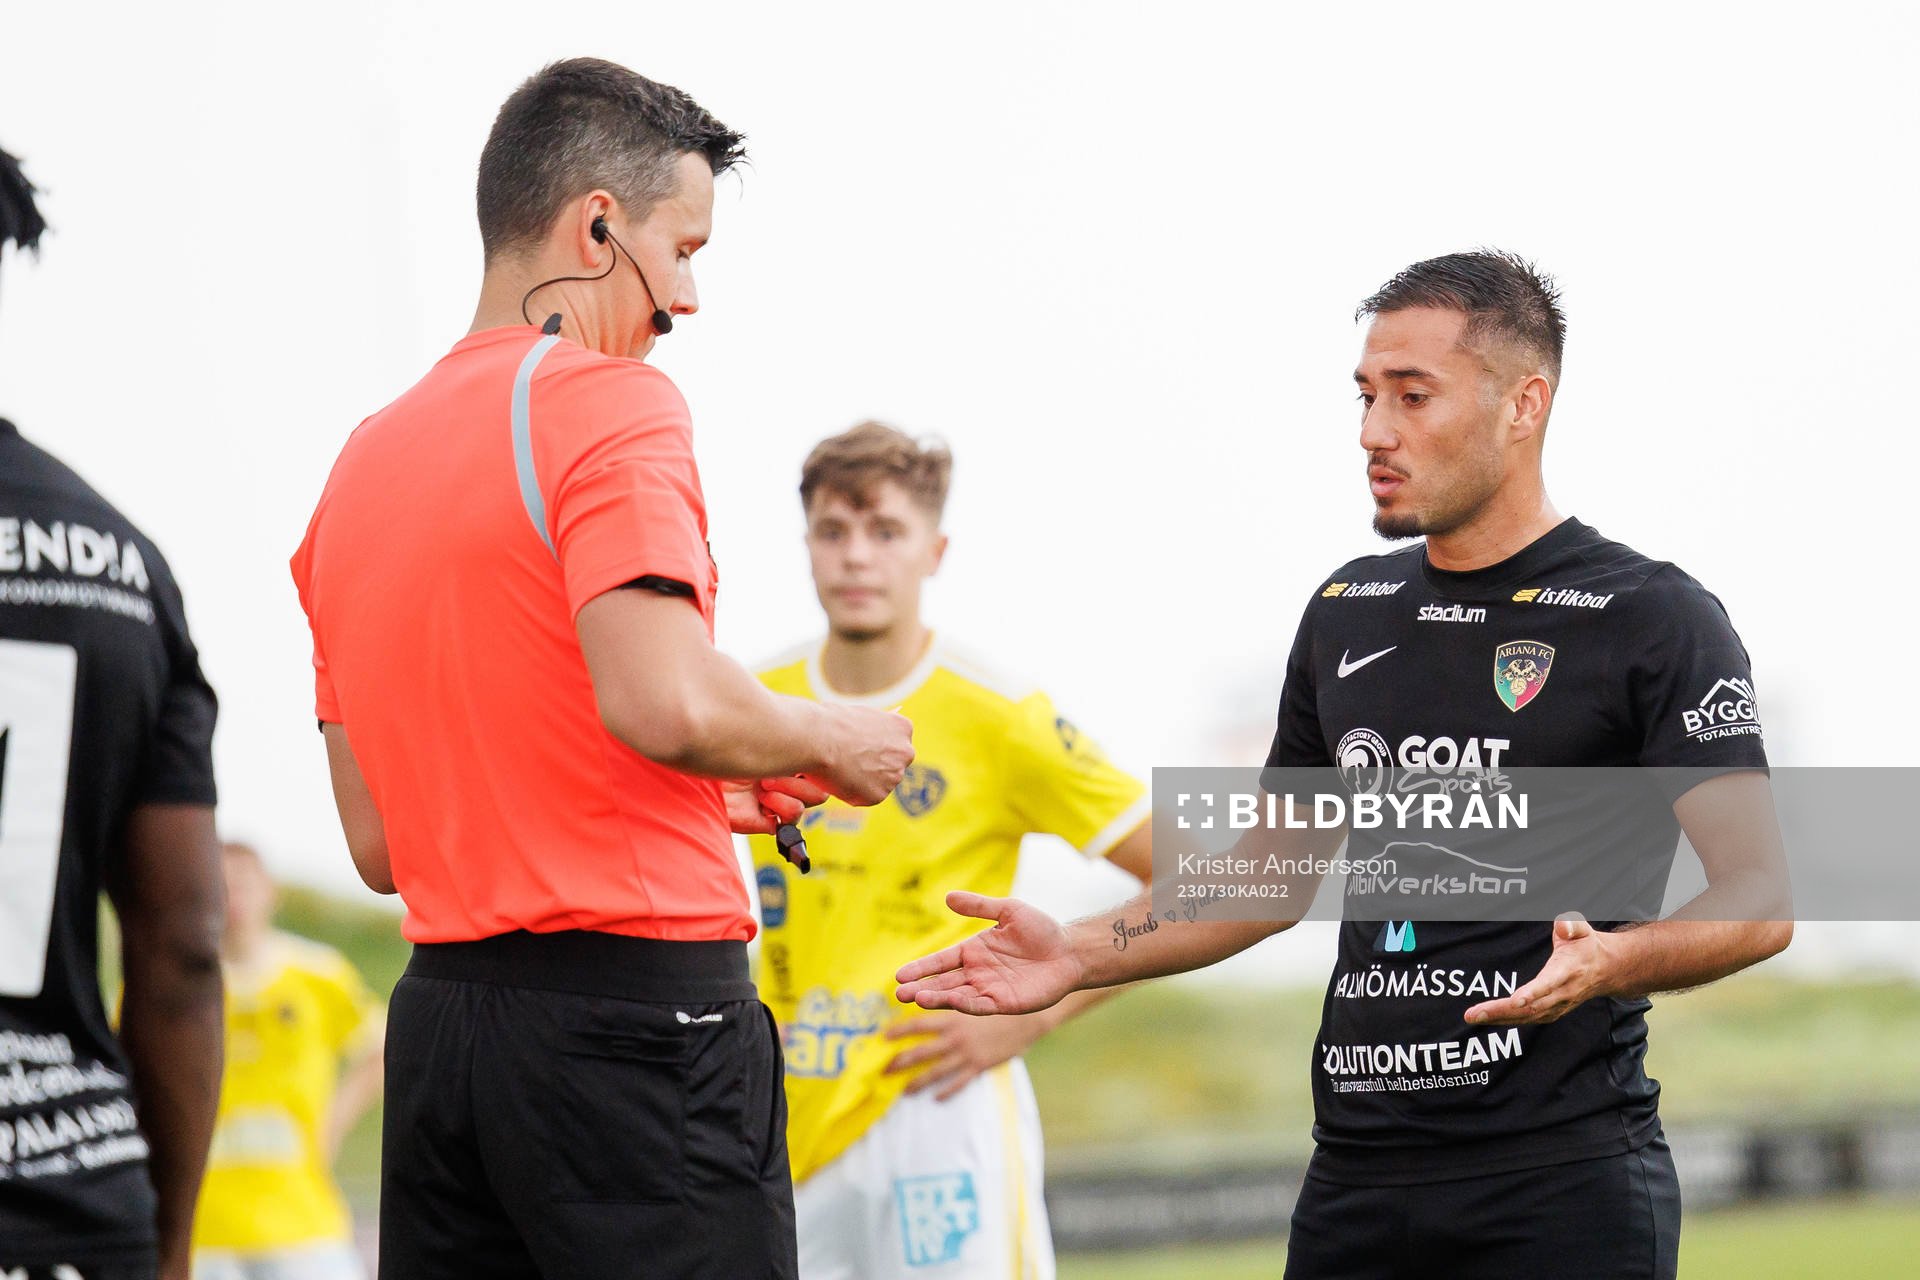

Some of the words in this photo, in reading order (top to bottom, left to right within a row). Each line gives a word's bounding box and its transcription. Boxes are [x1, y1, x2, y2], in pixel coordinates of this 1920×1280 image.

[1342, 580, 1406, 598] istikbal
[1536, 587, 1615, 609] istikbal
[1417, 603, 1487, 623] stadium
[1499, 646, 1537, 659] ARIANA
[1537, 648, 1552, 660] FC
[1346, 731, 1372, 744] FACTORY
[1370, 736, 1387, 757] GROUP
[1398, 735, 1510, 776] GOAT
[1113, 911, 1159, 952] Jacob
[1385, 1070, 1489, 1092] helhetslösning
